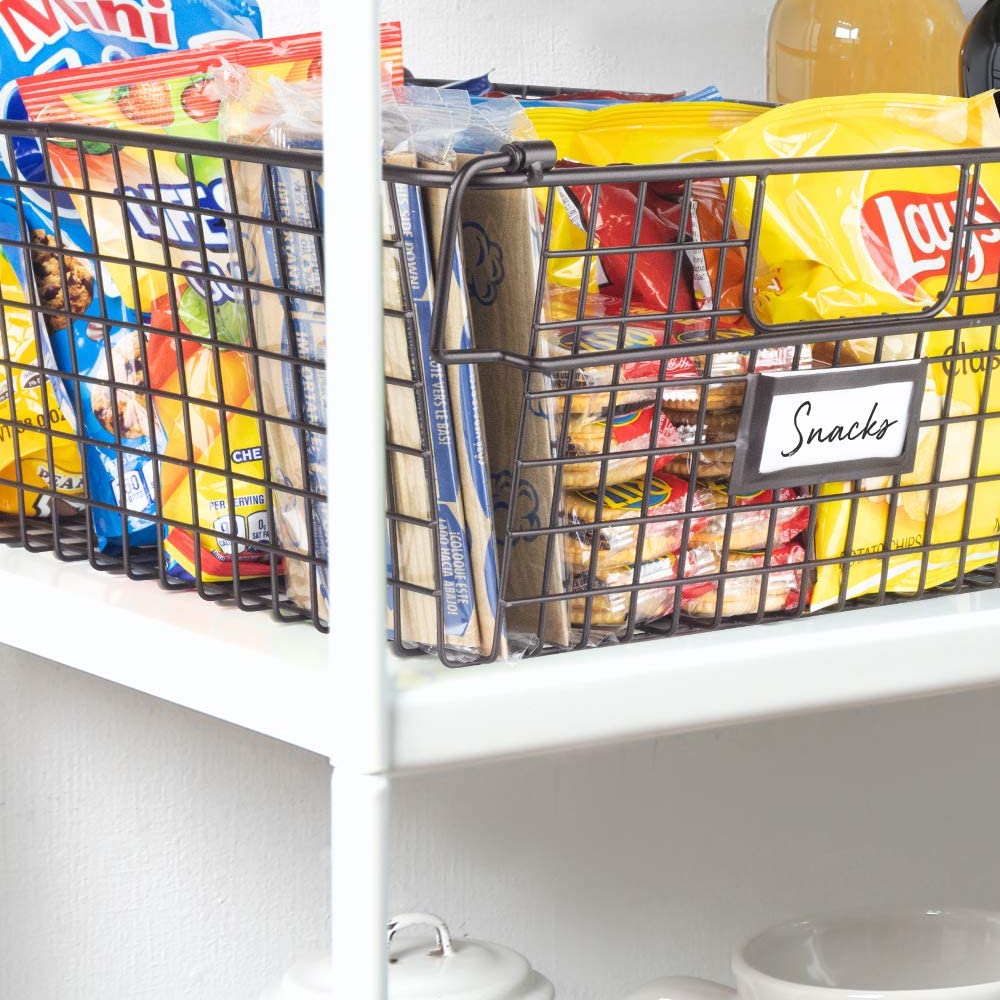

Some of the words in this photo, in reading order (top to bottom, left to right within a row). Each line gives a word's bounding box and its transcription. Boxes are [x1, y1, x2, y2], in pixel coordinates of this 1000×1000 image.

[406, 242, 420, 291] DOWN!
[430, 382, 445, 408] VERS
[435, 409, 447, 422] LE
[437, 423, 450, 446] BAS!
[781, 401, 902, 459] Snacks
[209, 500, 226, 510] PER
[229, 494, 265, 507] ERVING
[442, 548, 454, 583] HACIA
[446, 582, 460, 616] ABAJO!
[457, 584, 470, 605] ESTE
